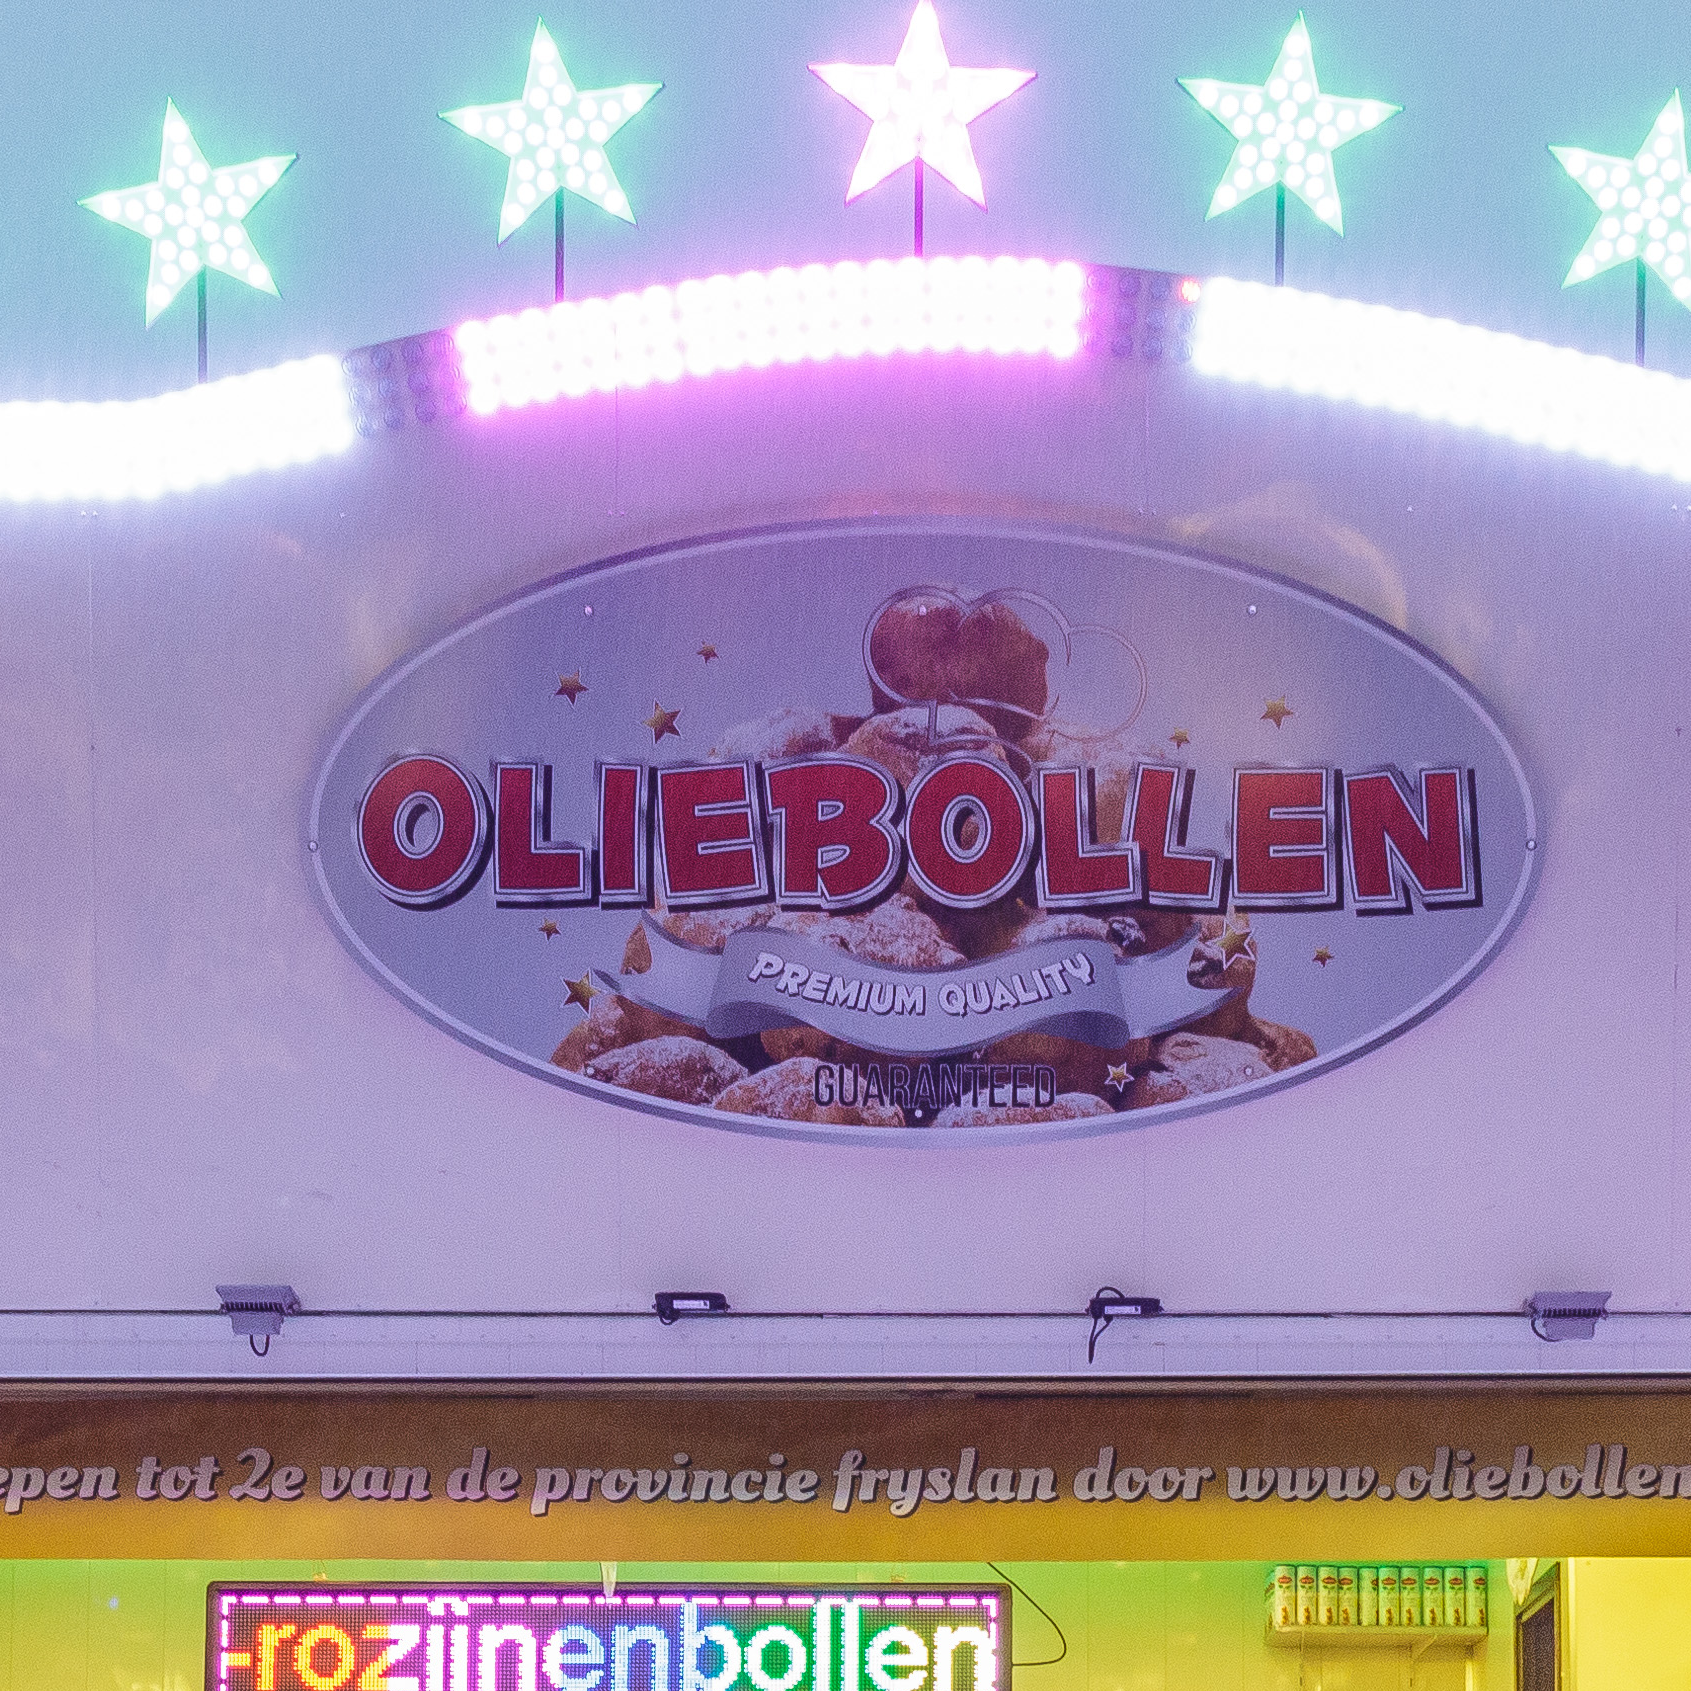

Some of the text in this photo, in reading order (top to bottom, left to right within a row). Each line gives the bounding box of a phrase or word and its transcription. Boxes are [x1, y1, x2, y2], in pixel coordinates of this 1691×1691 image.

[357, 752, 1483, 915] OLIEBOLLEN
[747, 951, 1097, 1017] PREMIUM QUALITY
[812, 1062, 1058, 1110] GUARANTEED
[135, 1455, 224, 1501] tot
[229, 1446, 307, 1502] 2e
[319, 1463, 432, 1502] van
[445, 1446, 521, 1503] de
[531, 1452, 818, 1517] provincie
[831, 1446, 1061, 1518] fryslan
[1073, 1446, 1215, 1502] door
